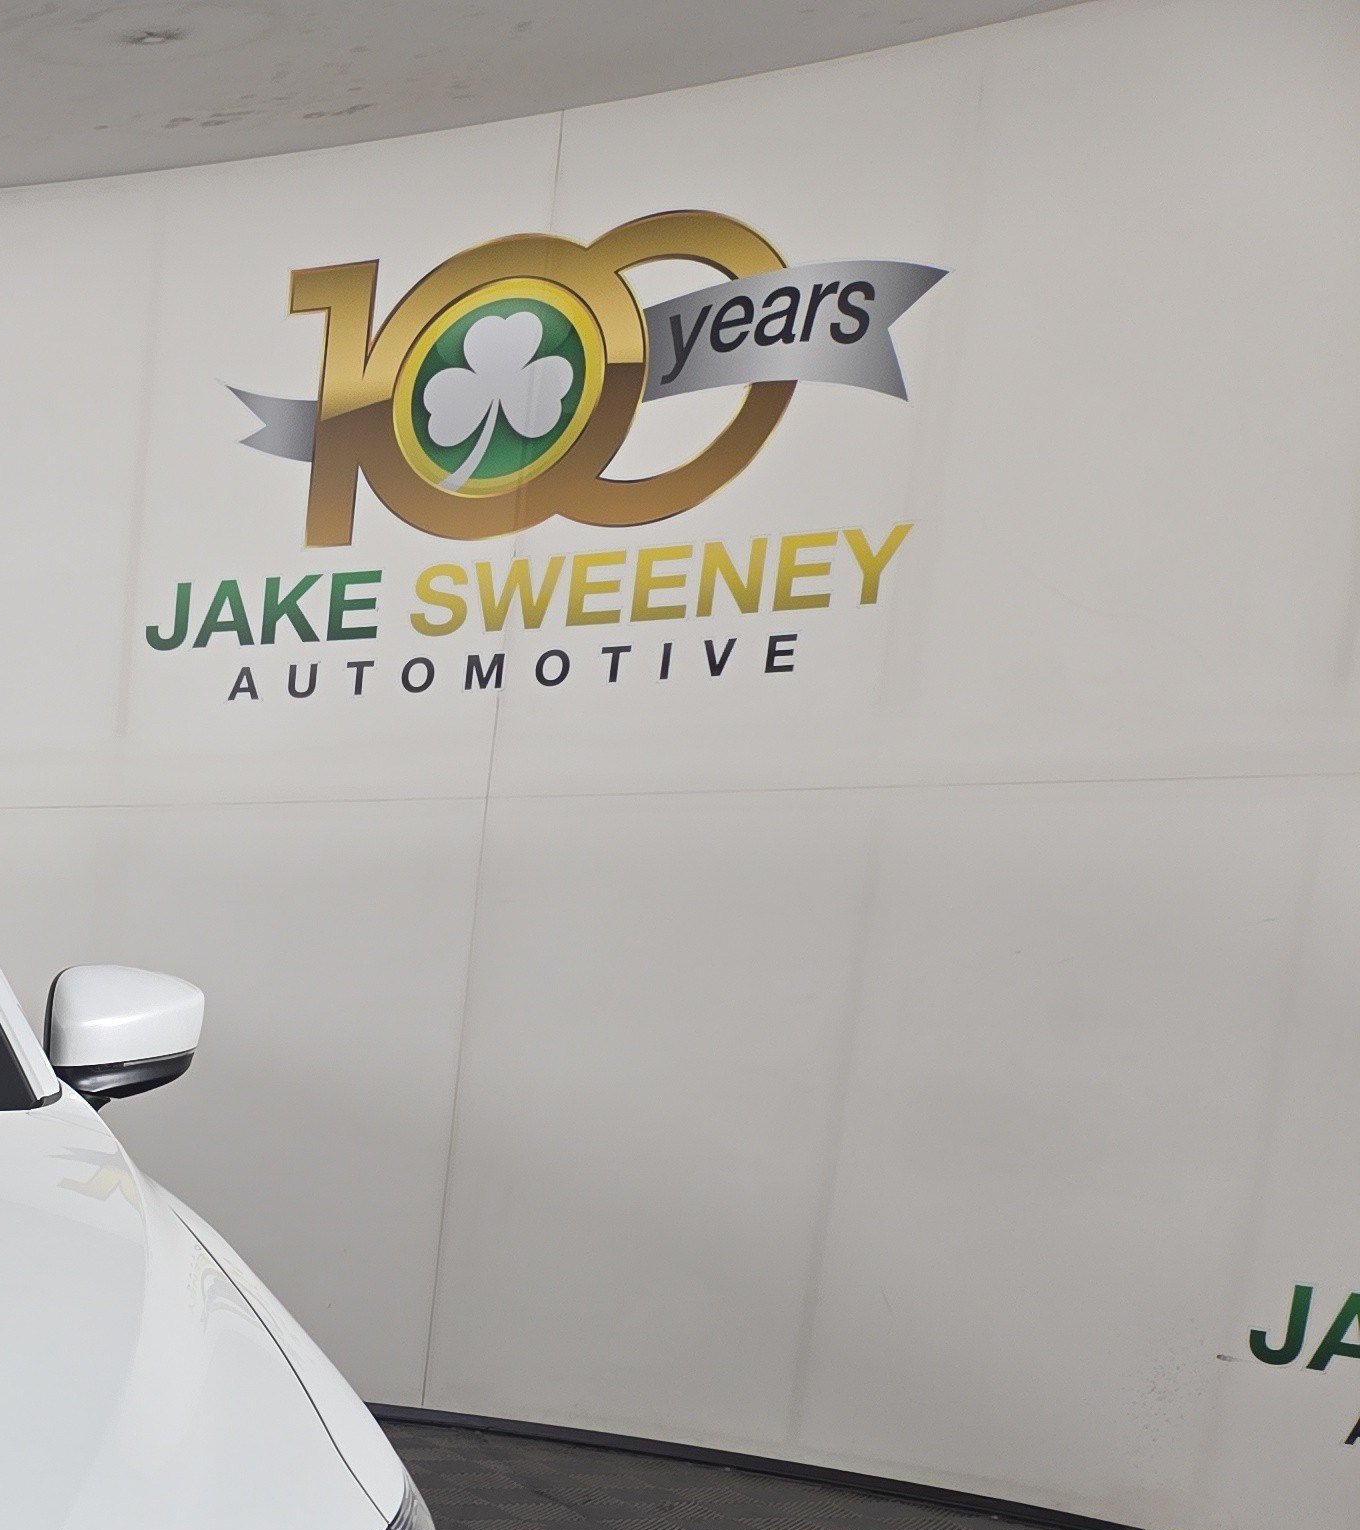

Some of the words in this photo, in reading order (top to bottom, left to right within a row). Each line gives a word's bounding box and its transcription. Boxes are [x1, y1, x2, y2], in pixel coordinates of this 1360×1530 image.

[288, 209, 798, 549] 100
[659, 280, 876, 386] years
[145, 569, 384, 652] JAKE
[409, 524, 915, 638] SWEENEY
[227, 633, 799, 703] AUTOMOTIVE
